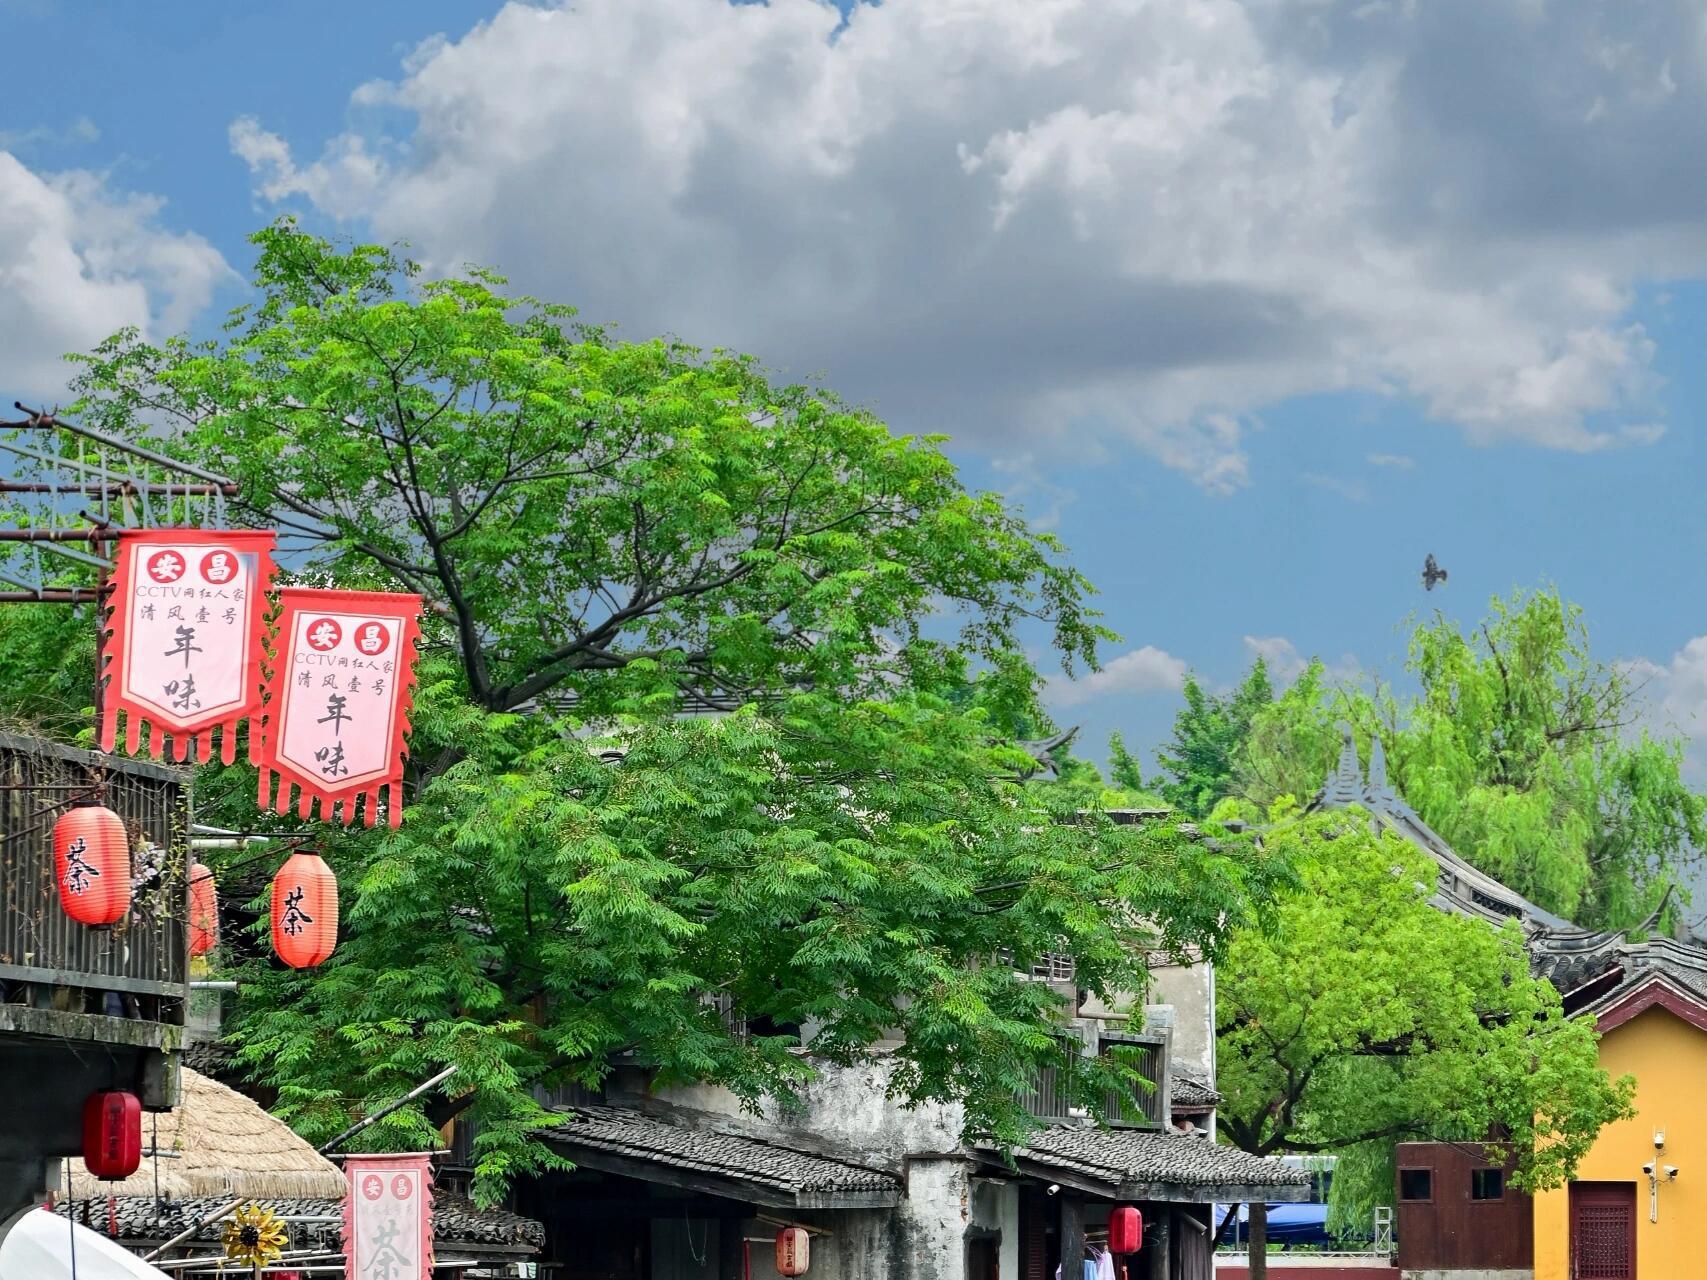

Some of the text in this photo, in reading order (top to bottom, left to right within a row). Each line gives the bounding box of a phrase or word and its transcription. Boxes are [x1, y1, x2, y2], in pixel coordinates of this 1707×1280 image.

[150, 552, 232, 582] 安昌
[141, 603, 237, 625] 清风壹号
[309, 620, 383, 653] 安昌
[164, 624, 203, 711] 年味
[298, 670, 385, 696] 清风壹号
[314, 692, 352, 777] 年味
[64, 837, 99, 894] 茶
[279, 886, 313, 937] 茶
[364, 1177, 409, 1197] 安昌
